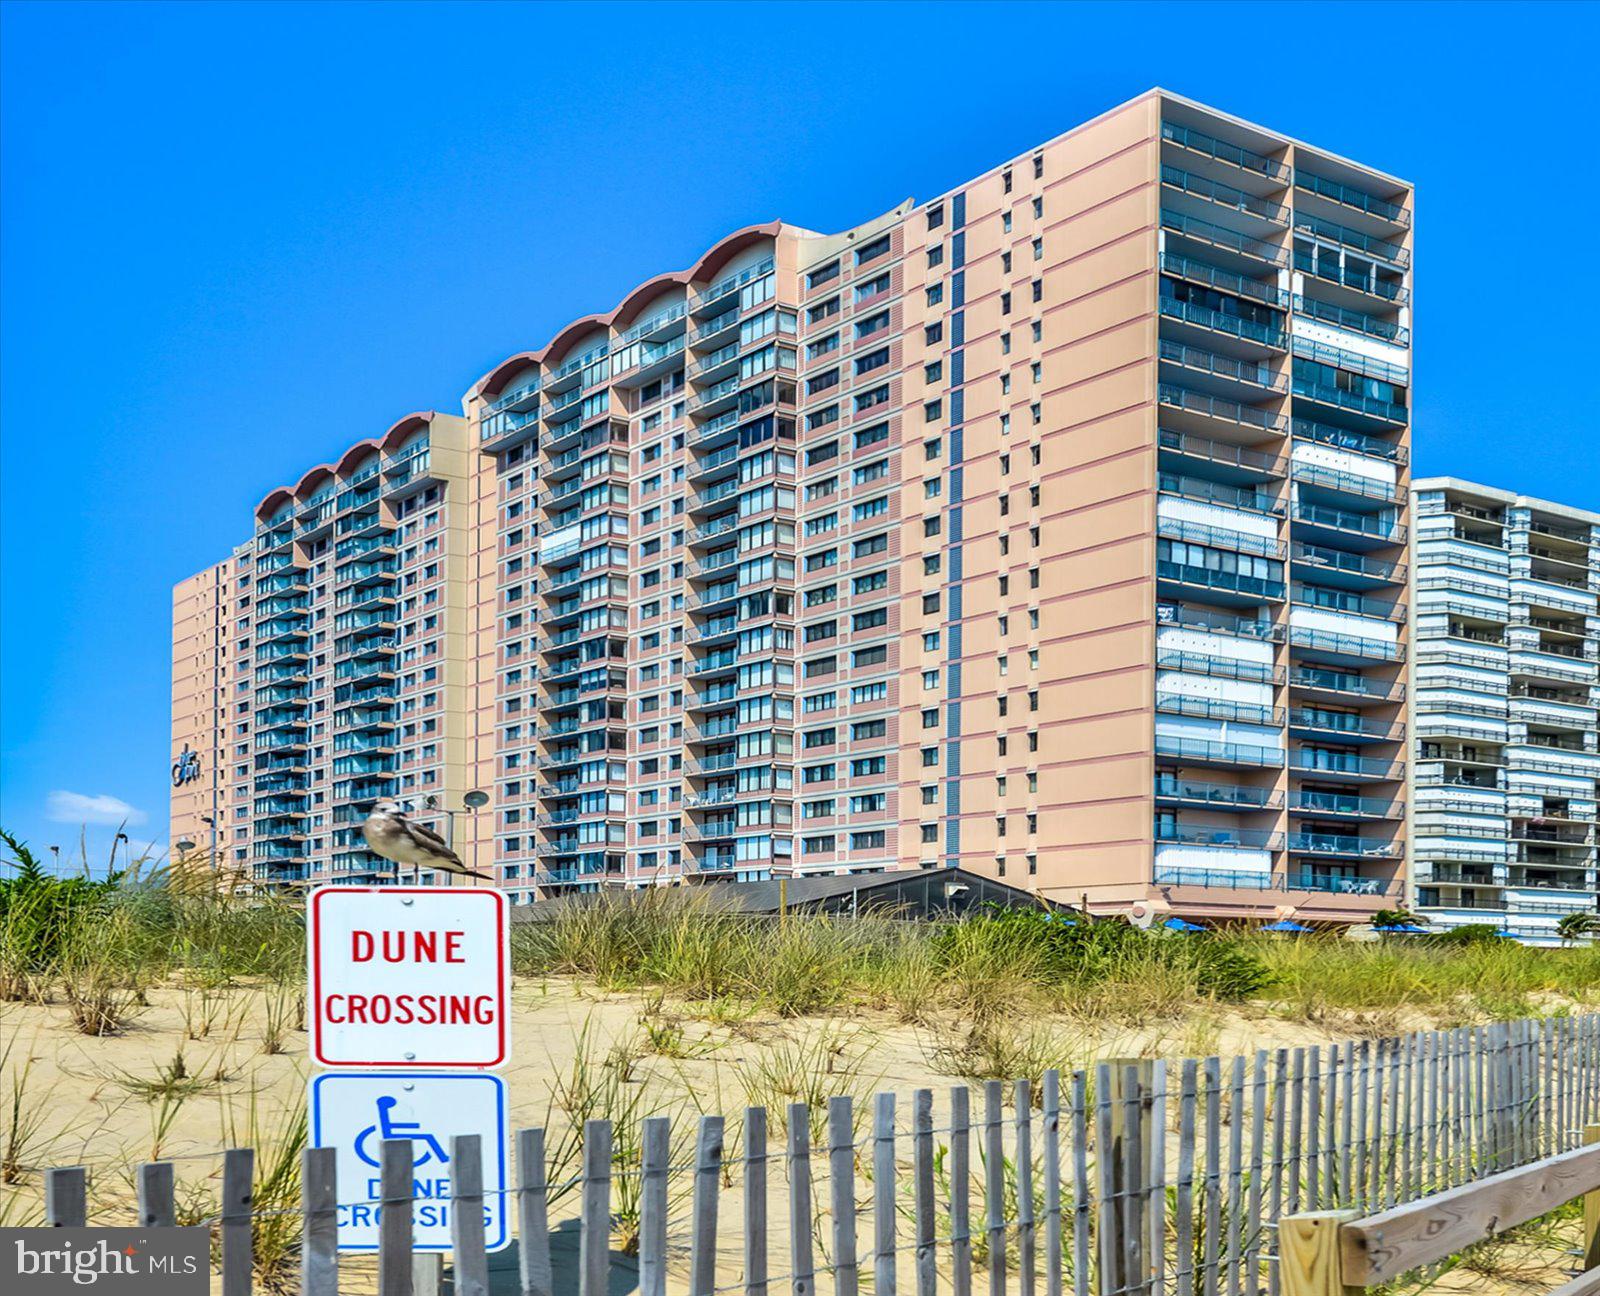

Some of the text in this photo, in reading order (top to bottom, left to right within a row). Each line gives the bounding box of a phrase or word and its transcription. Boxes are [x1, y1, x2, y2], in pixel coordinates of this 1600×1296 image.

[352, 931, 466, 963] DUNE
[325, 994, 494, 1025] CROSSING
[367, 1178, 451, 1200] DNE
